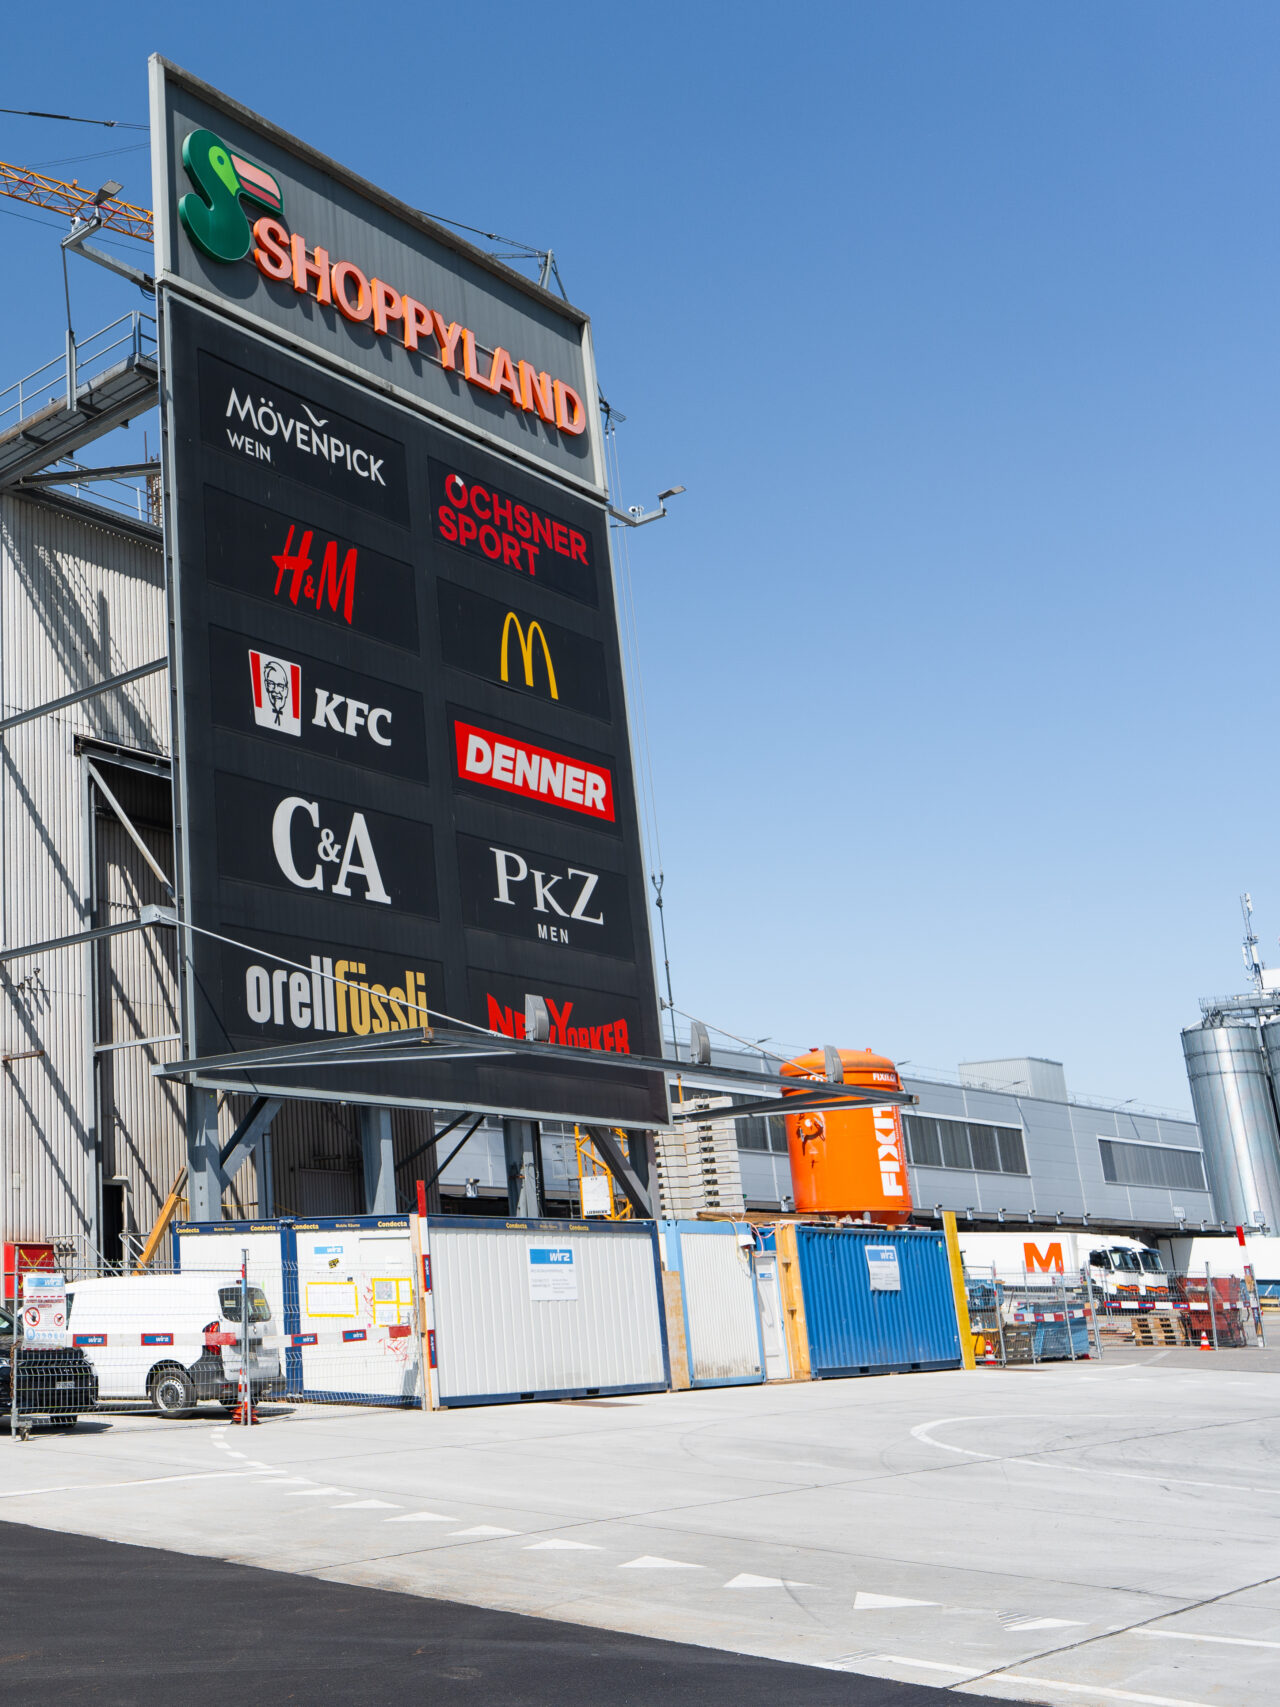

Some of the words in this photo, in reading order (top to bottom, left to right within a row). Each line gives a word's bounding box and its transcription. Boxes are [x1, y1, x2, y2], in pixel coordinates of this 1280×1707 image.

[253, 217, 587, 436] SHOPPYLAND
[225, 387, 387, 487] MÖVENPICK
[226, 429, 272, 463] WEIN
[438, 505, 539, 576] SPORT
[445, 473, 589, 567] OCHSNER
[272, 524, 358, 625] H&M
[312, 687, 393, 747] KFC
[465, 733, 607, 812] DENNER
[272, 796, 391, 904] C&A
[489, 847, 604, 925] PKZ
[537, 923, 569, 944] MEN
[549, 1249, 570, 1262] wirz
[1023, 1242, 1065, 1273] M
